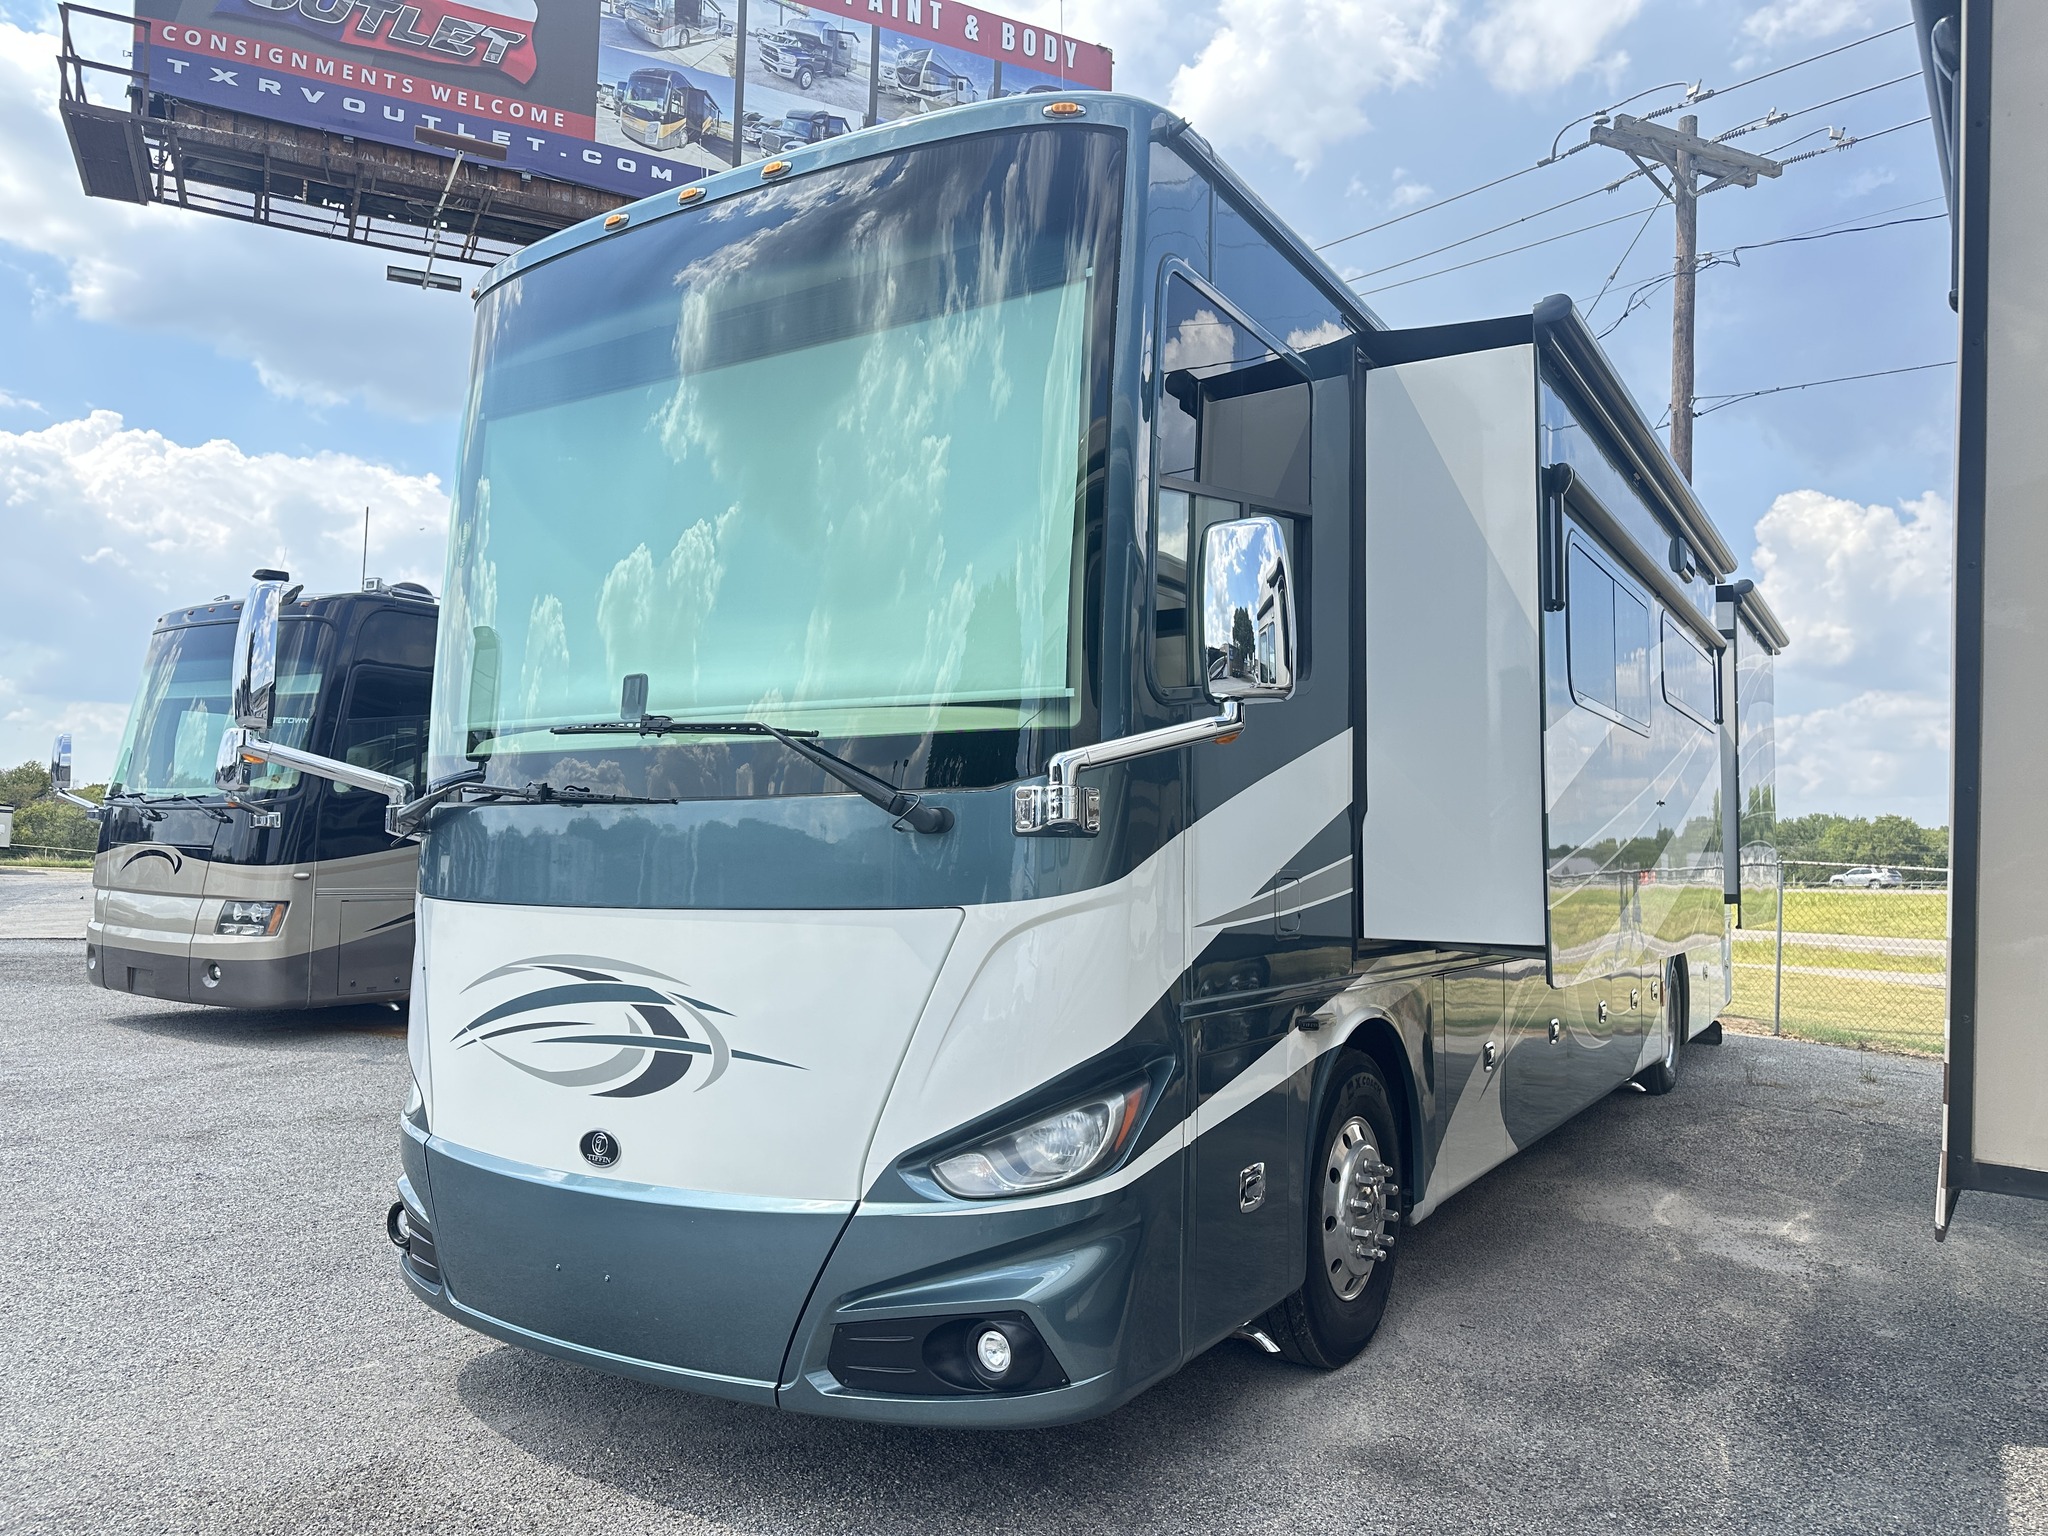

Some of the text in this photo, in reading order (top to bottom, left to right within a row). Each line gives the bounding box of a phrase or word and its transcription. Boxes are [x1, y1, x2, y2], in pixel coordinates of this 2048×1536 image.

[247, 0, 527, 64] UTLET
[964, 14, 979, 41] &
[1002, 22, 1077, 68] BODY
[162, 26, 565, 127] CONSIGNMENTS WELCOME
[166, 58, 672, 182] TXRVOUTLET.COM
